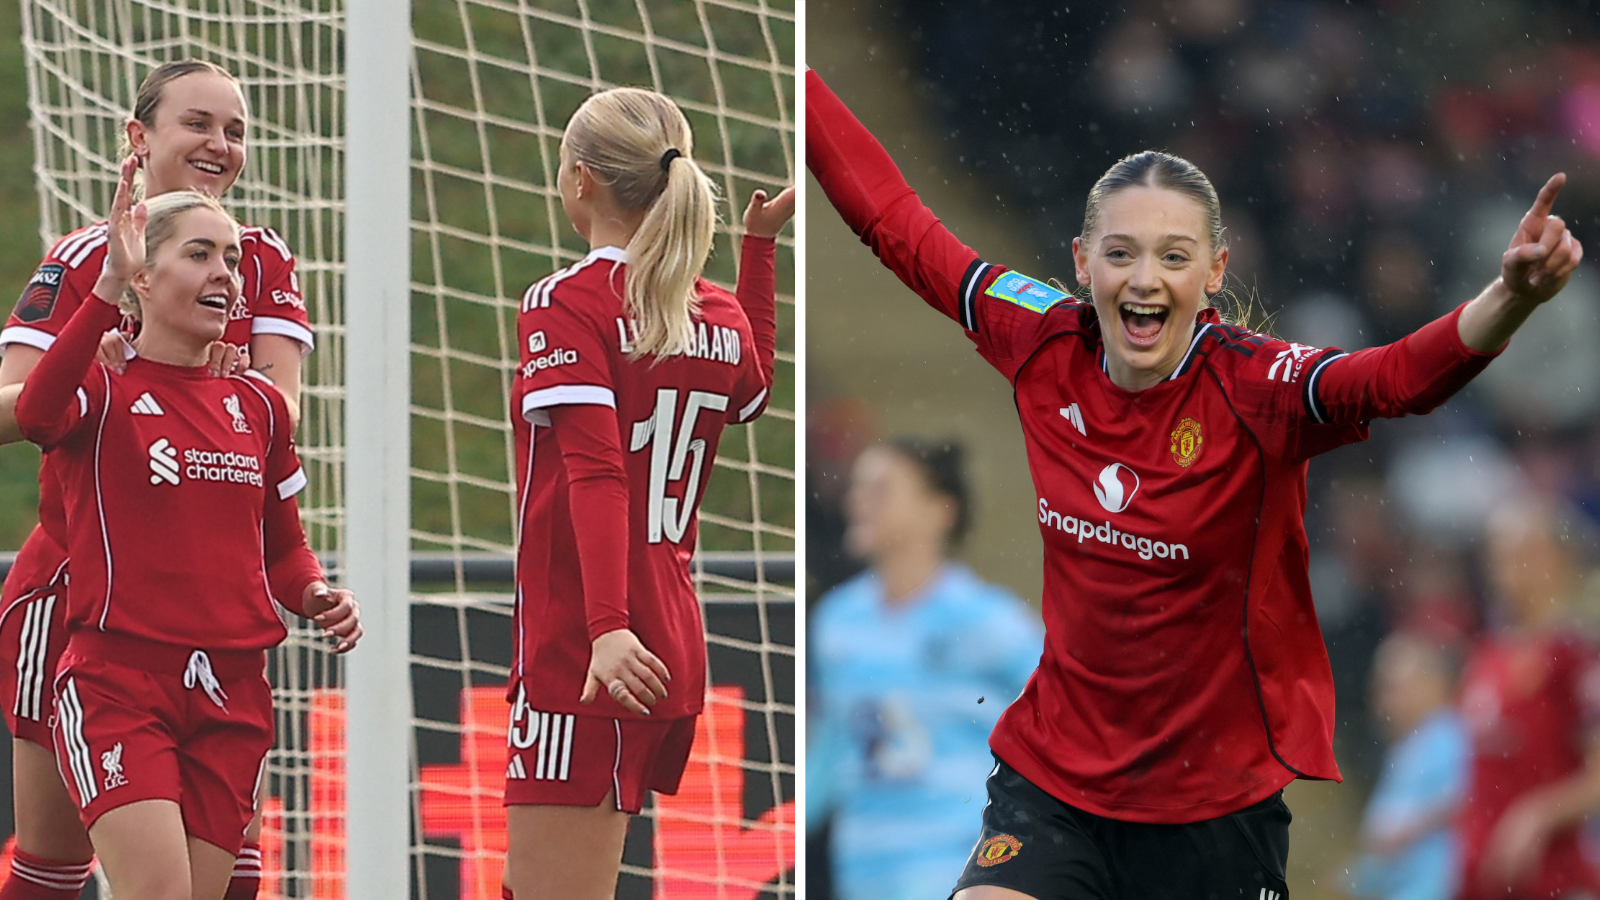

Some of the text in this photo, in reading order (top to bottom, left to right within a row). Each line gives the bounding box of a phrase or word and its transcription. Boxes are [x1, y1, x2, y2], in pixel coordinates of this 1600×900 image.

[616, 317, 741, 366] LGAARD
[184, 447, 260, 471] standard
[186, 464, 263, 488] chartered
[629, 388, 730, 545] 15
[1038, 498, 1190, 561] Snapdragon
[507, 681, 540, 750] 5
